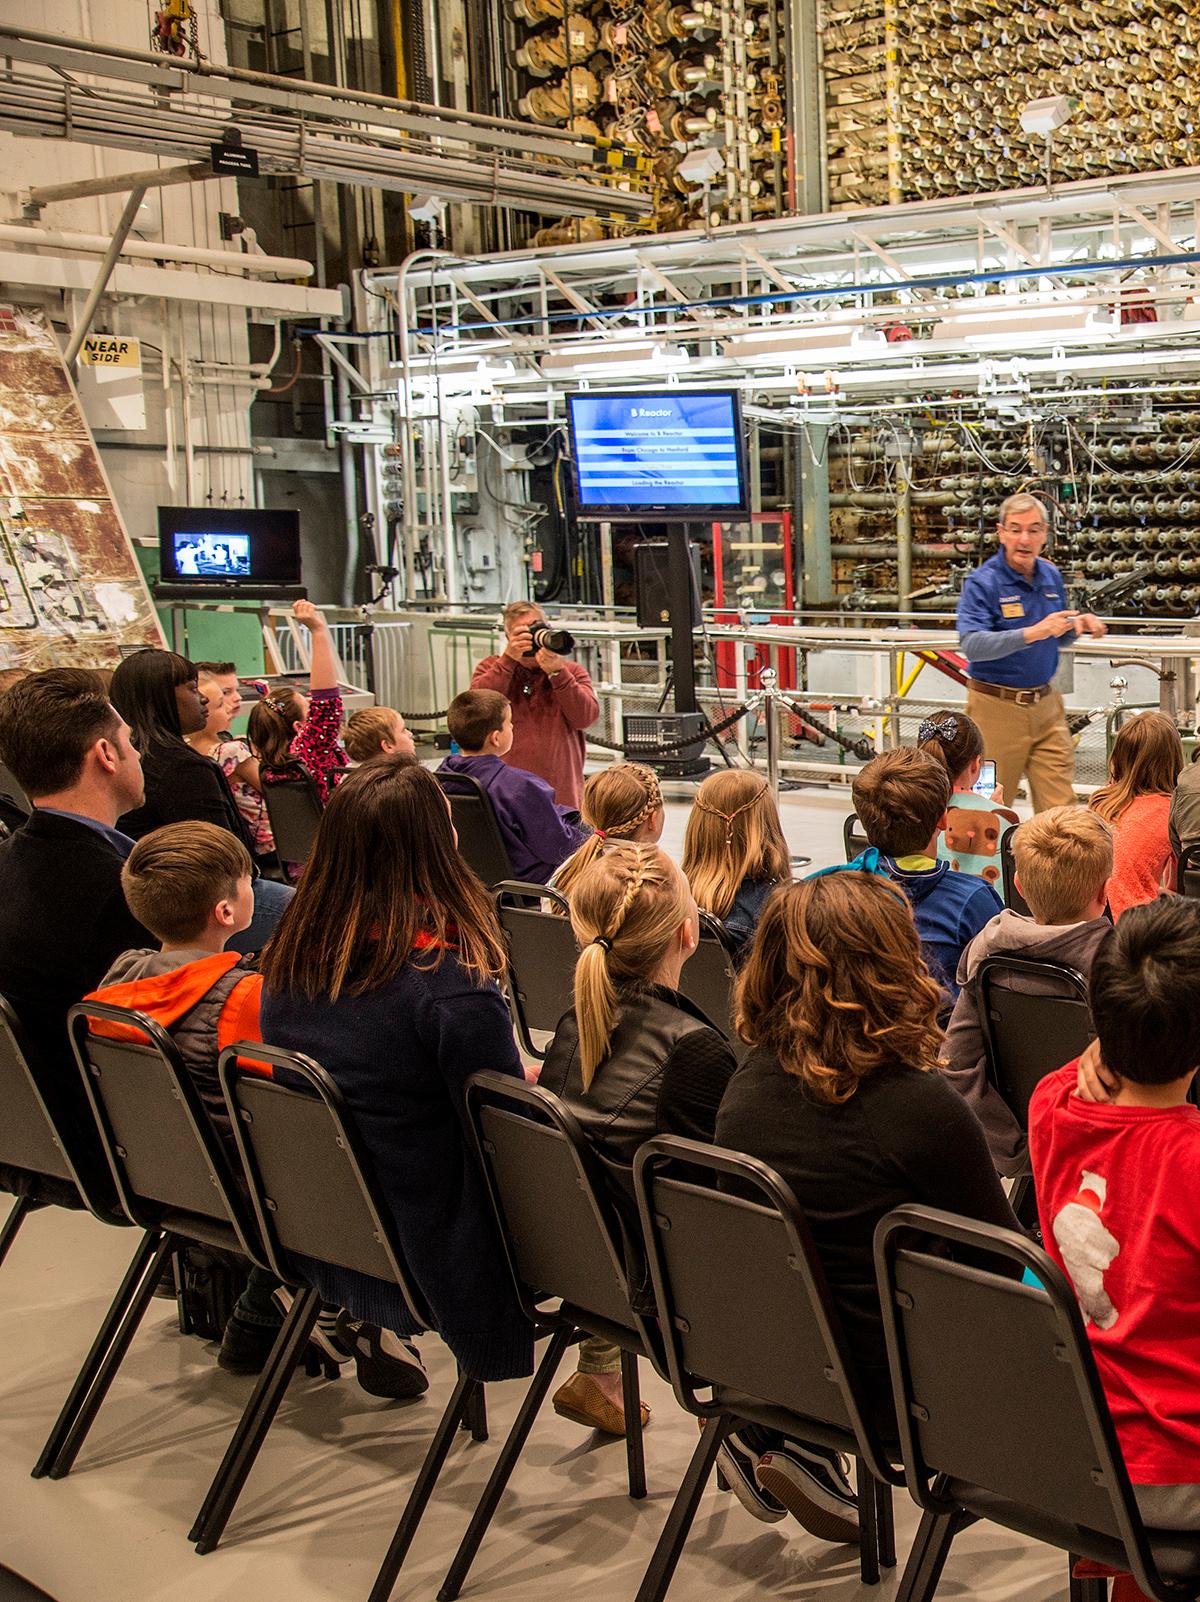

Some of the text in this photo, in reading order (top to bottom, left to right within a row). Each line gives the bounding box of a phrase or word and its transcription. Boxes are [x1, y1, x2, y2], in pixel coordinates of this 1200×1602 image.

[84, 340, 129, 354] NEAR
[91, 353, 121, 363] SIDE
[631, 408, 673, 418] B Reactor
